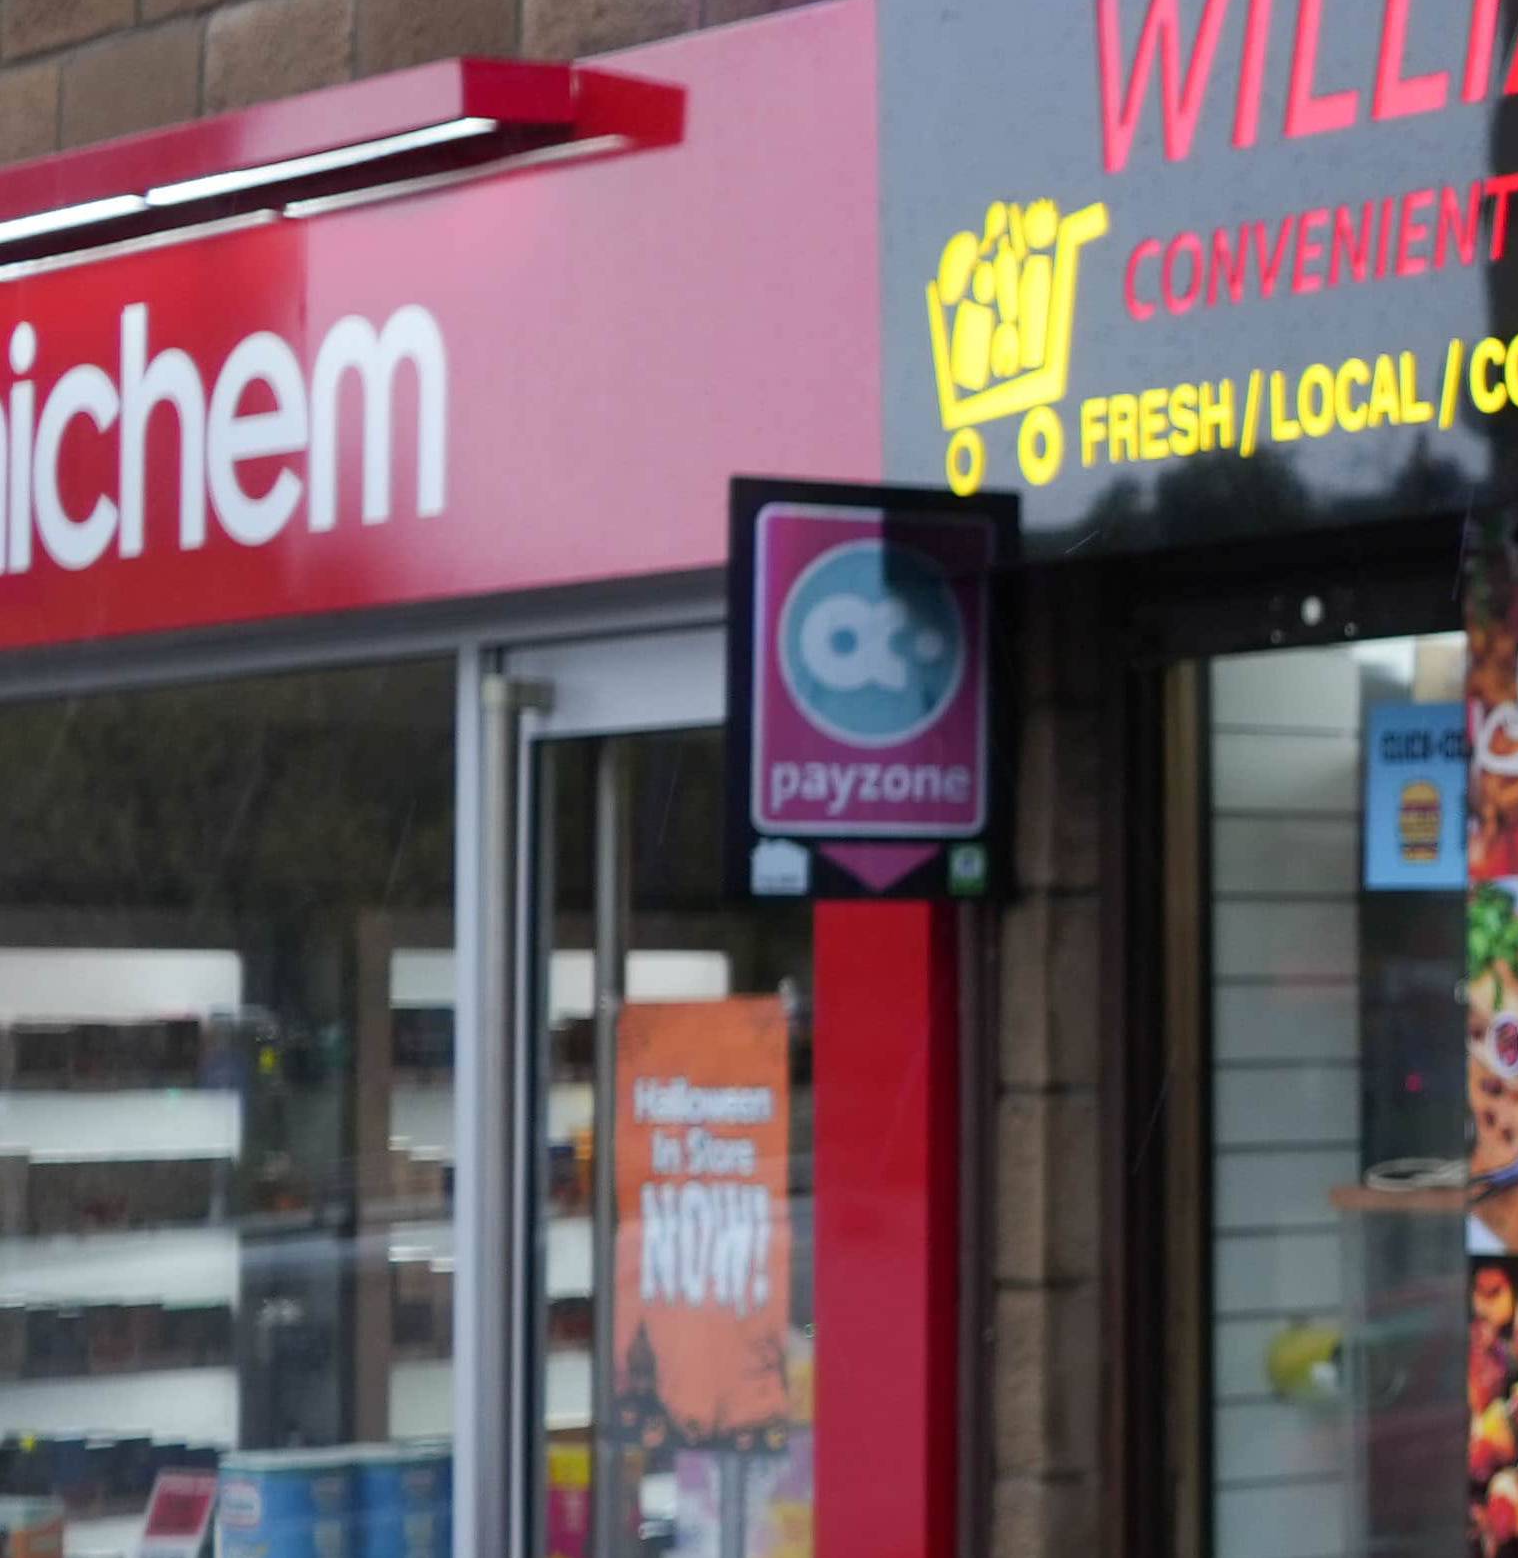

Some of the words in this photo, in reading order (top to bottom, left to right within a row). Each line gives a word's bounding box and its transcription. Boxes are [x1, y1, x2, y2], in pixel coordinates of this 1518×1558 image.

[0, 303, 447, 575] ichem
[1081, 380, 1236, 464] FRESH
[1240, 372, 1262, 457] /
[1271, 353, 1435, 443] LOCAL
[1441, 341, 1465, 428] /
[769, 761, 972, 816] payzone
[633, 1076, 775, 1125] Halloween
[689, 1128, 756, 1174] Store
[640, 1182, 771, 1317] NOW!
